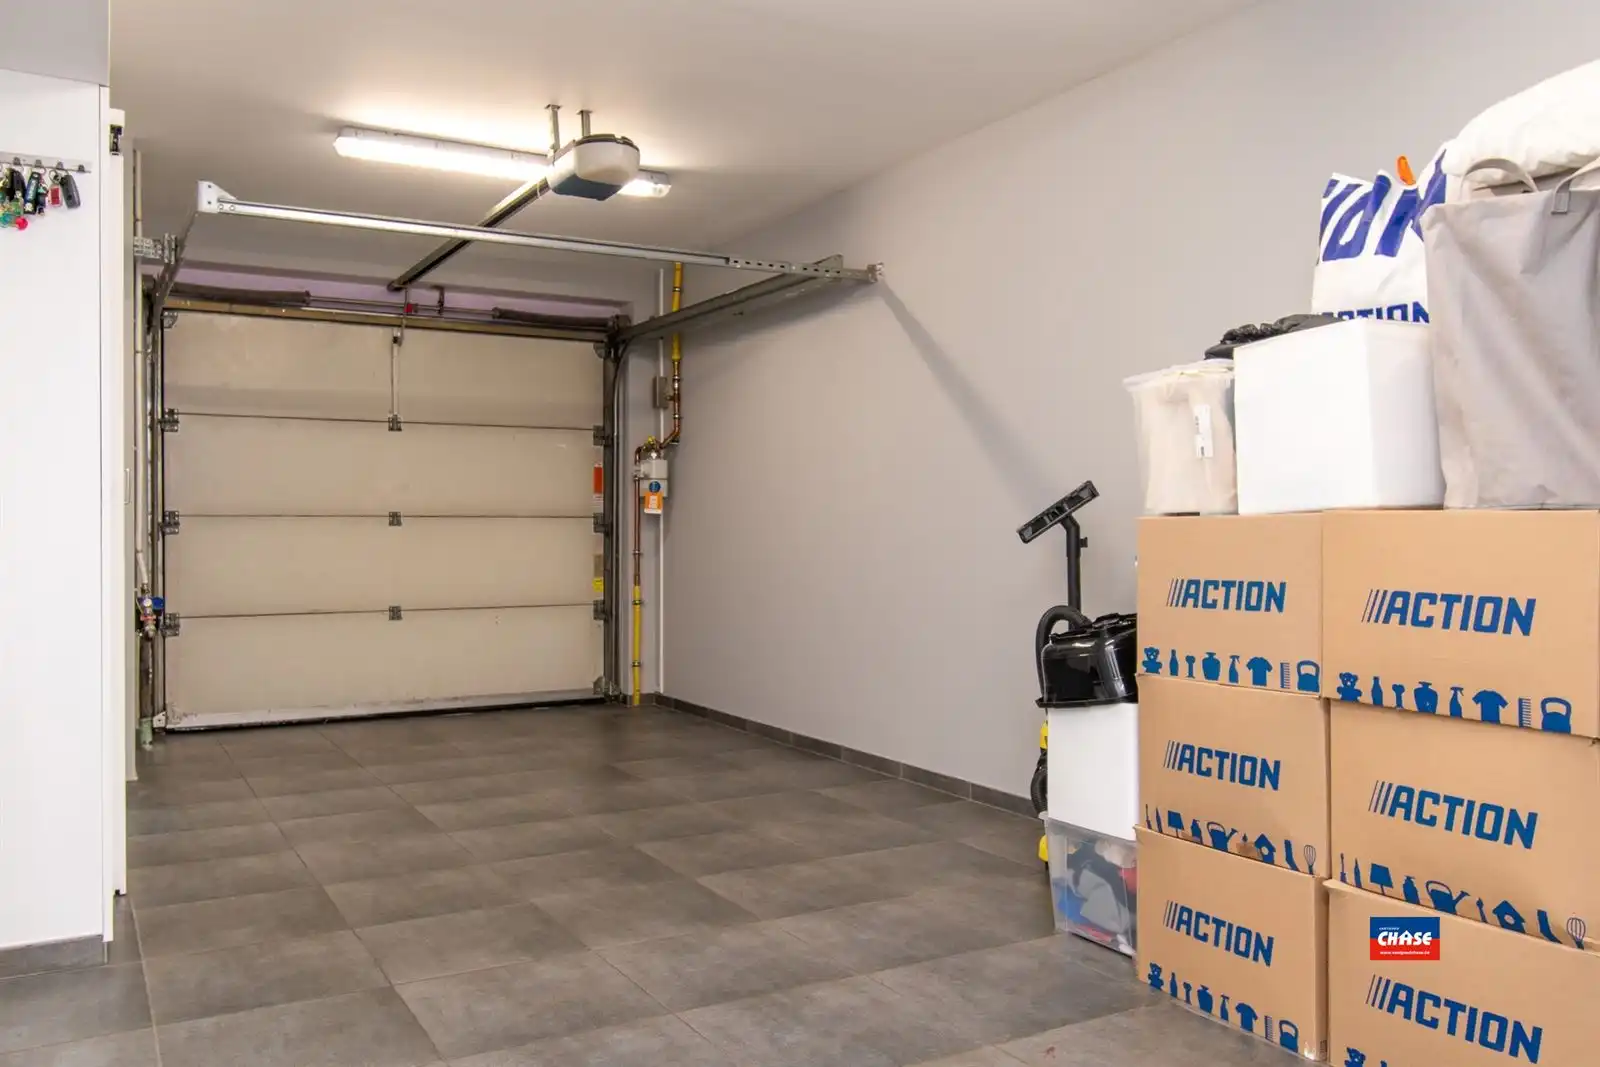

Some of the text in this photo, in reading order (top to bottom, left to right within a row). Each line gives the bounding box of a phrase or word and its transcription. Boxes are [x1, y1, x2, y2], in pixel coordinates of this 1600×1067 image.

[1182, 579, 1286, 612] ACTION
[1383, 590, 1536, 636] ACTION
[1177, 744, 1280, 790] ACTION
[1389, 785, 1538, 849] ACTION
[1175, 906, 1273, 966] ACTION
[1386, 982, 1543, 1064] ACTION
